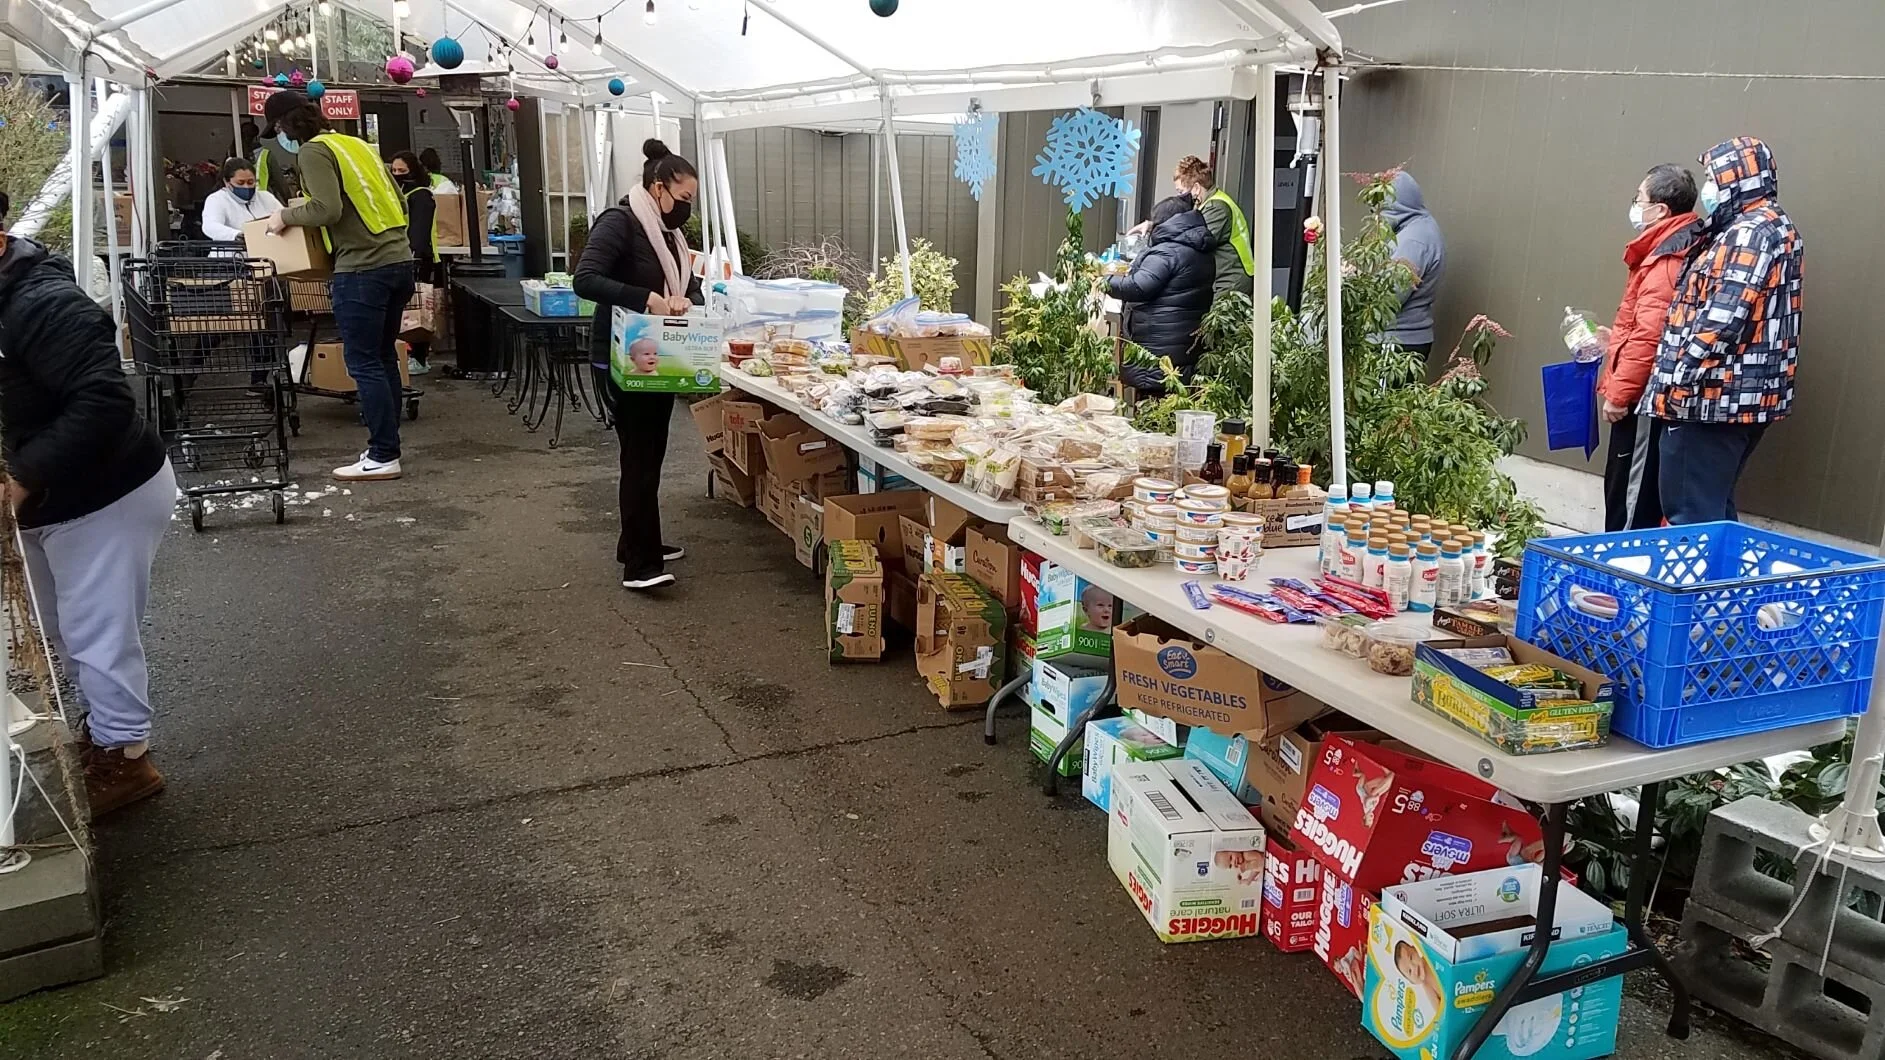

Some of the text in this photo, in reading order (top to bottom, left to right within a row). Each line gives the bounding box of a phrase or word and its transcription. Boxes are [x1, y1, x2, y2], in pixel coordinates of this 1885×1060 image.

[253, 91, 275, 100] STA
[325, 95, 353, 104] STAFF
[327, 107, 353, 116] ONLY
[662, 331, 719, 344] BabyWipes
[626, 380, 641, 388] 900
[706, 432, 724, 443] HUGG
[1263, 521, 1283, 532] blue
[1021, 559, 1039, 593] HUGG
[868, 603, 878, 638] BUENO
[1078, 637, 1095, 648] 900
[1167, 649, 1181, 660] Eat
[1163, 656, 1190, 669] Smart
[1122, 670, 1247, 709] FRESH VEGETABLES
[1137, 693, 1231, 723] KEEP REFRIGERATED
[1550, 707, 1578, 716] GLUTEN
[1072, 760, 1083, 770] 90
[1324, 750, 1334, 765] 5
[1309, 793, 1338, 818] movers
[1392, 794, 1409, 813] 5
[1407, 801, 1421, 811] 88
[1294, 808, 1363, 879] HUGGIES
[1423, 841, 1469, 863] movers
[1129, 872, 1152, 914] GGIES
[1361, 894, 1370, 909] 5
[1170, 906, 1231, 917] natural care
[1291, 911, 1312, 920] OUR
[1314, 868, 1336, 963] HUGGIE
[1434, 905, 1485, 921] ULTRA SOFT
[1168, 913, 1257, 935] HUGGIES
[1274, 920, 1282, 936] 6
[1455, 980, 1495, 996] Pampers
[1391, 978, 1406, 1033] Pampers
